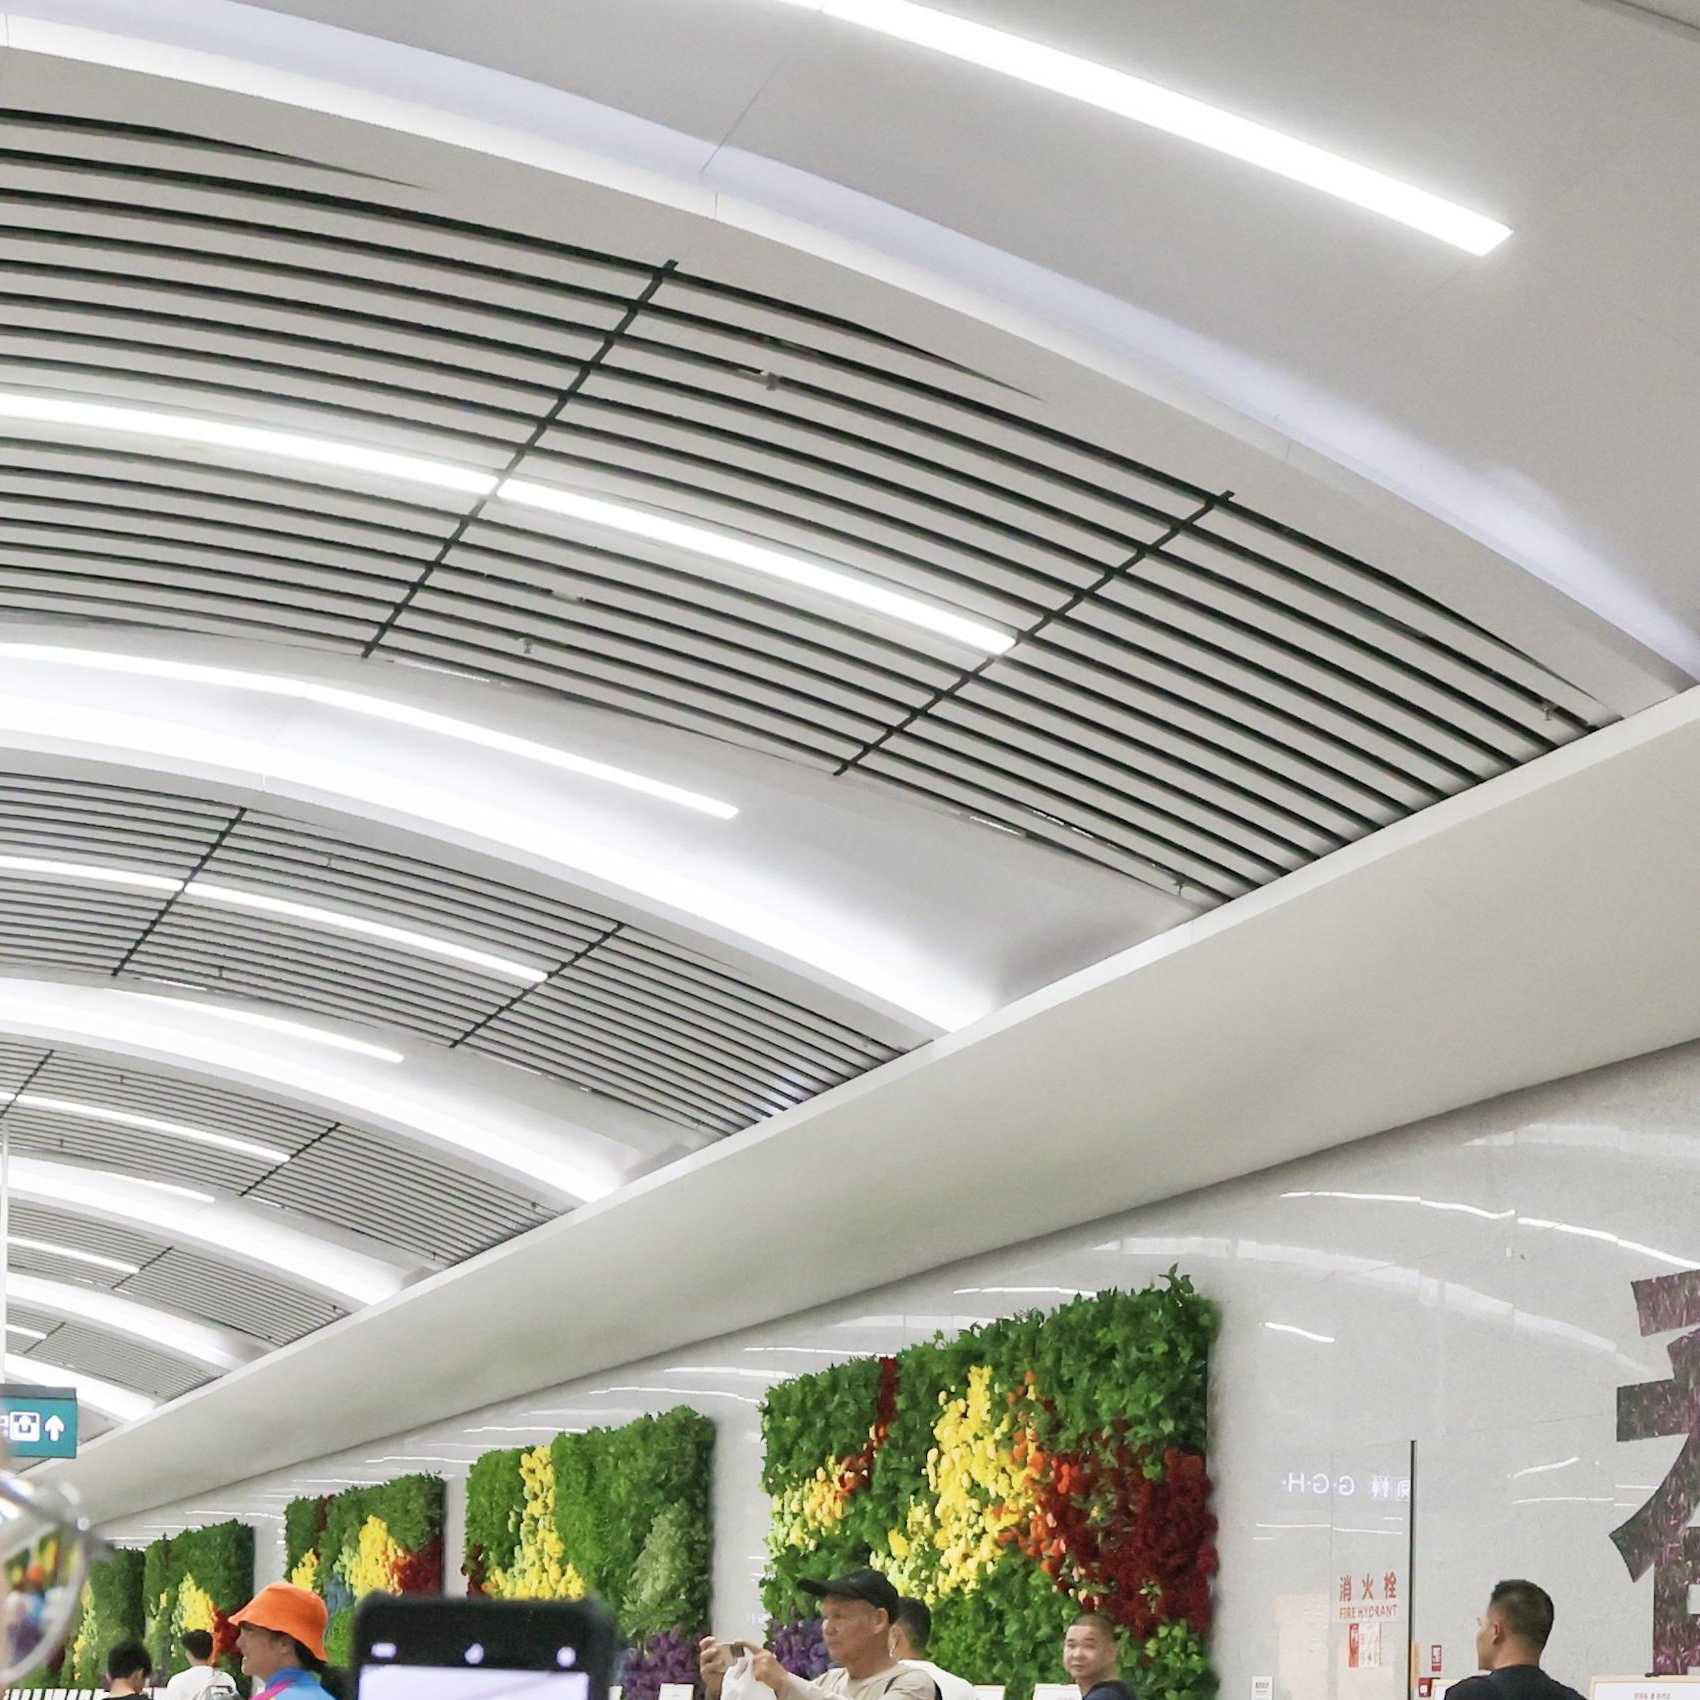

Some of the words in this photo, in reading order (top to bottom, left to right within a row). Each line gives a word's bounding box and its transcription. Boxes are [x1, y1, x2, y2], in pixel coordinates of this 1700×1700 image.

[1339, 1571, 1397, 1602] 消火栓
[1339, 1606, 1356, 1620] FIRE
[1357, 1604, 1397, 1618] HYDRANT
